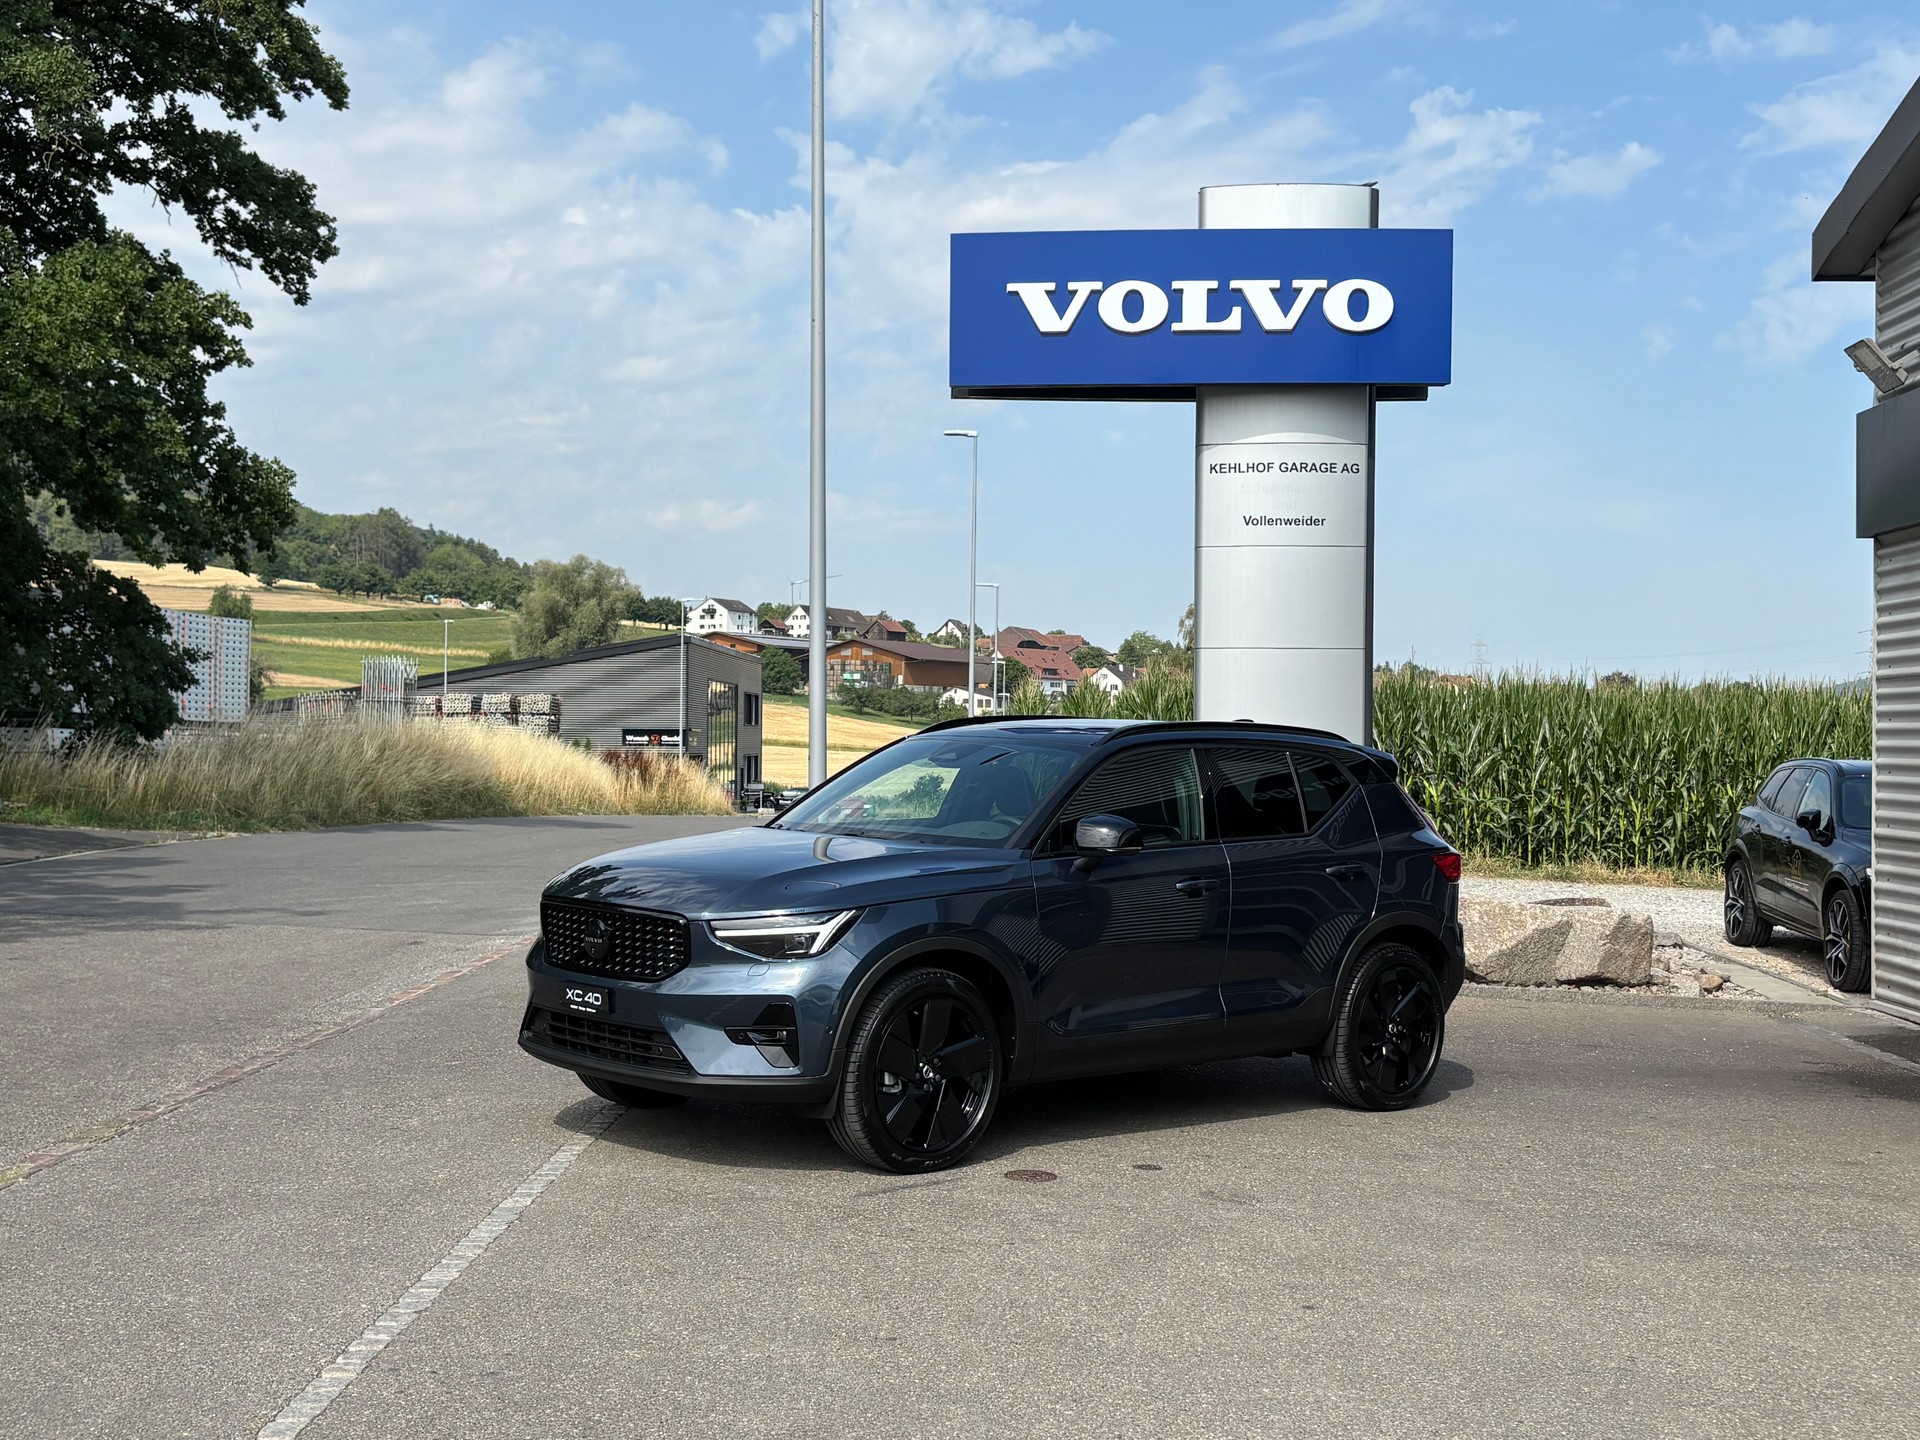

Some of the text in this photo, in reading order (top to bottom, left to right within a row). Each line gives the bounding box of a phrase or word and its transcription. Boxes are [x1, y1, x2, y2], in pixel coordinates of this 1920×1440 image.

[1006, 278, 1395, 334] VOLVO
[1209, 462, 1360, 474] KEHLHOF GARAGE AG
[1243, 516, 1326, 526] Vollenweider
[566, 988, 601, 1005] XC 40
